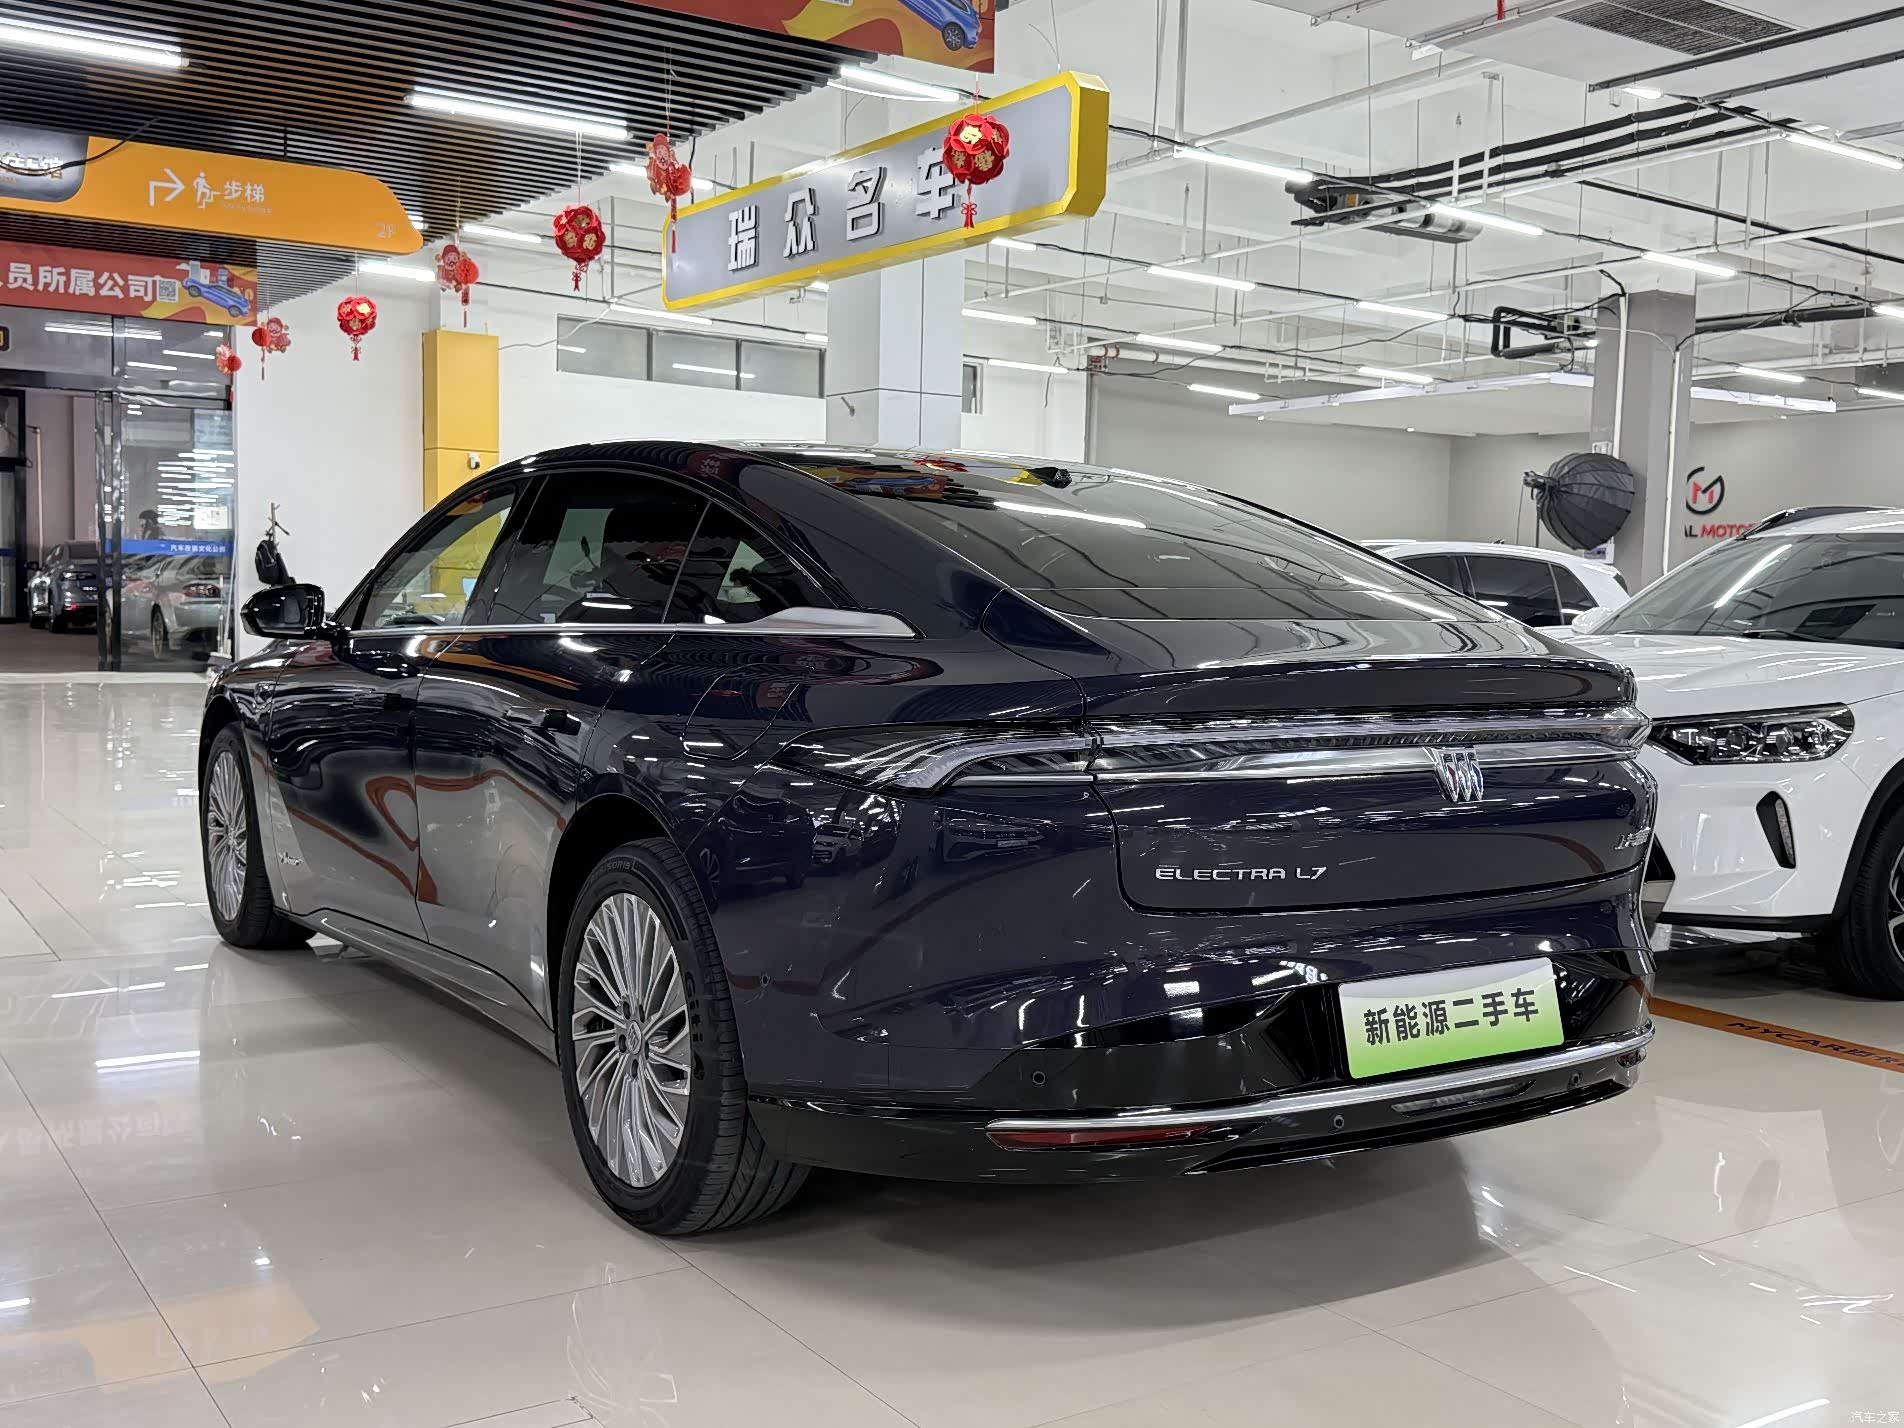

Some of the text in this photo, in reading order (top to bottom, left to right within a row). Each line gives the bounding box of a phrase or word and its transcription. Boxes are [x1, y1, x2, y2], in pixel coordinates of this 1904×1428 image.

[223, 180, 265, 203] 步梯
[728, 147, 957, 271] 瑞众名车
[0, 262, 157, 302] 员所属公司
[1155, 867, 1327, 881] ELECTRA L7
[1363, 987, 1540, 1046] 新能源二手车
